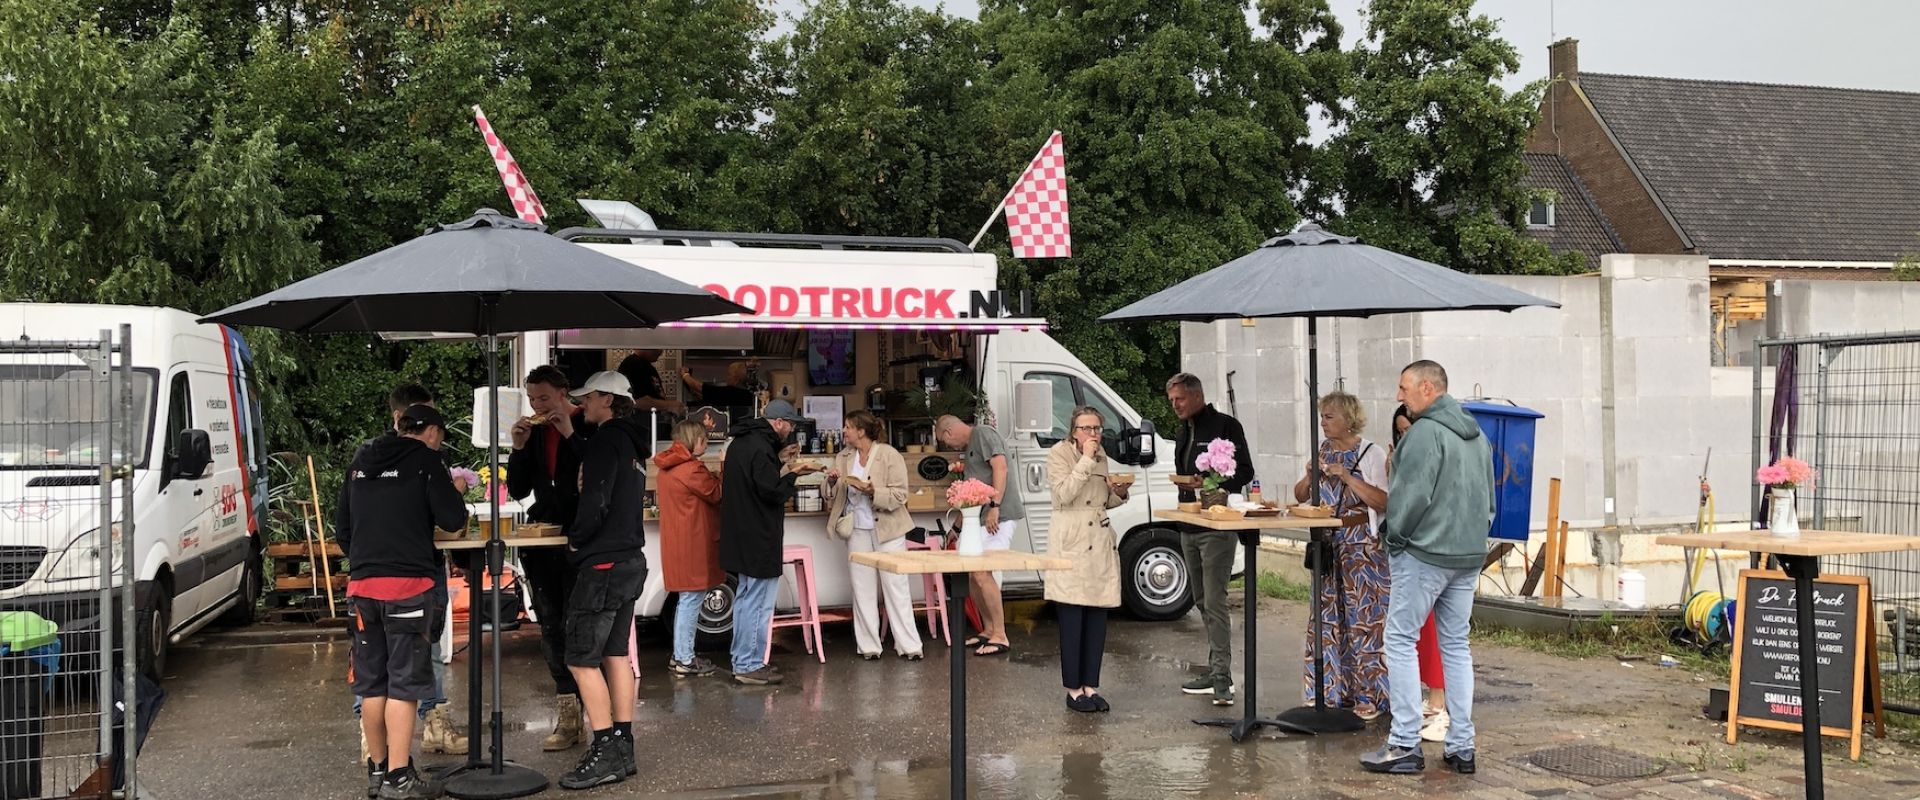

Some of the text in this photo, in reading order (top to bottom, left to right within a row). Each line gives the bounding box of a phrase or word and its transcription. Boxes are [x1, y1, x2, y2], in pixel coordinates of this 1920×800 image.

[1758, 586, 1780, 604] De
[1762, 614, 1787, 623] WELKOM
[1770, 627, 1776, 635] U
[1764, 691, 1803, 706] SMULLEN
